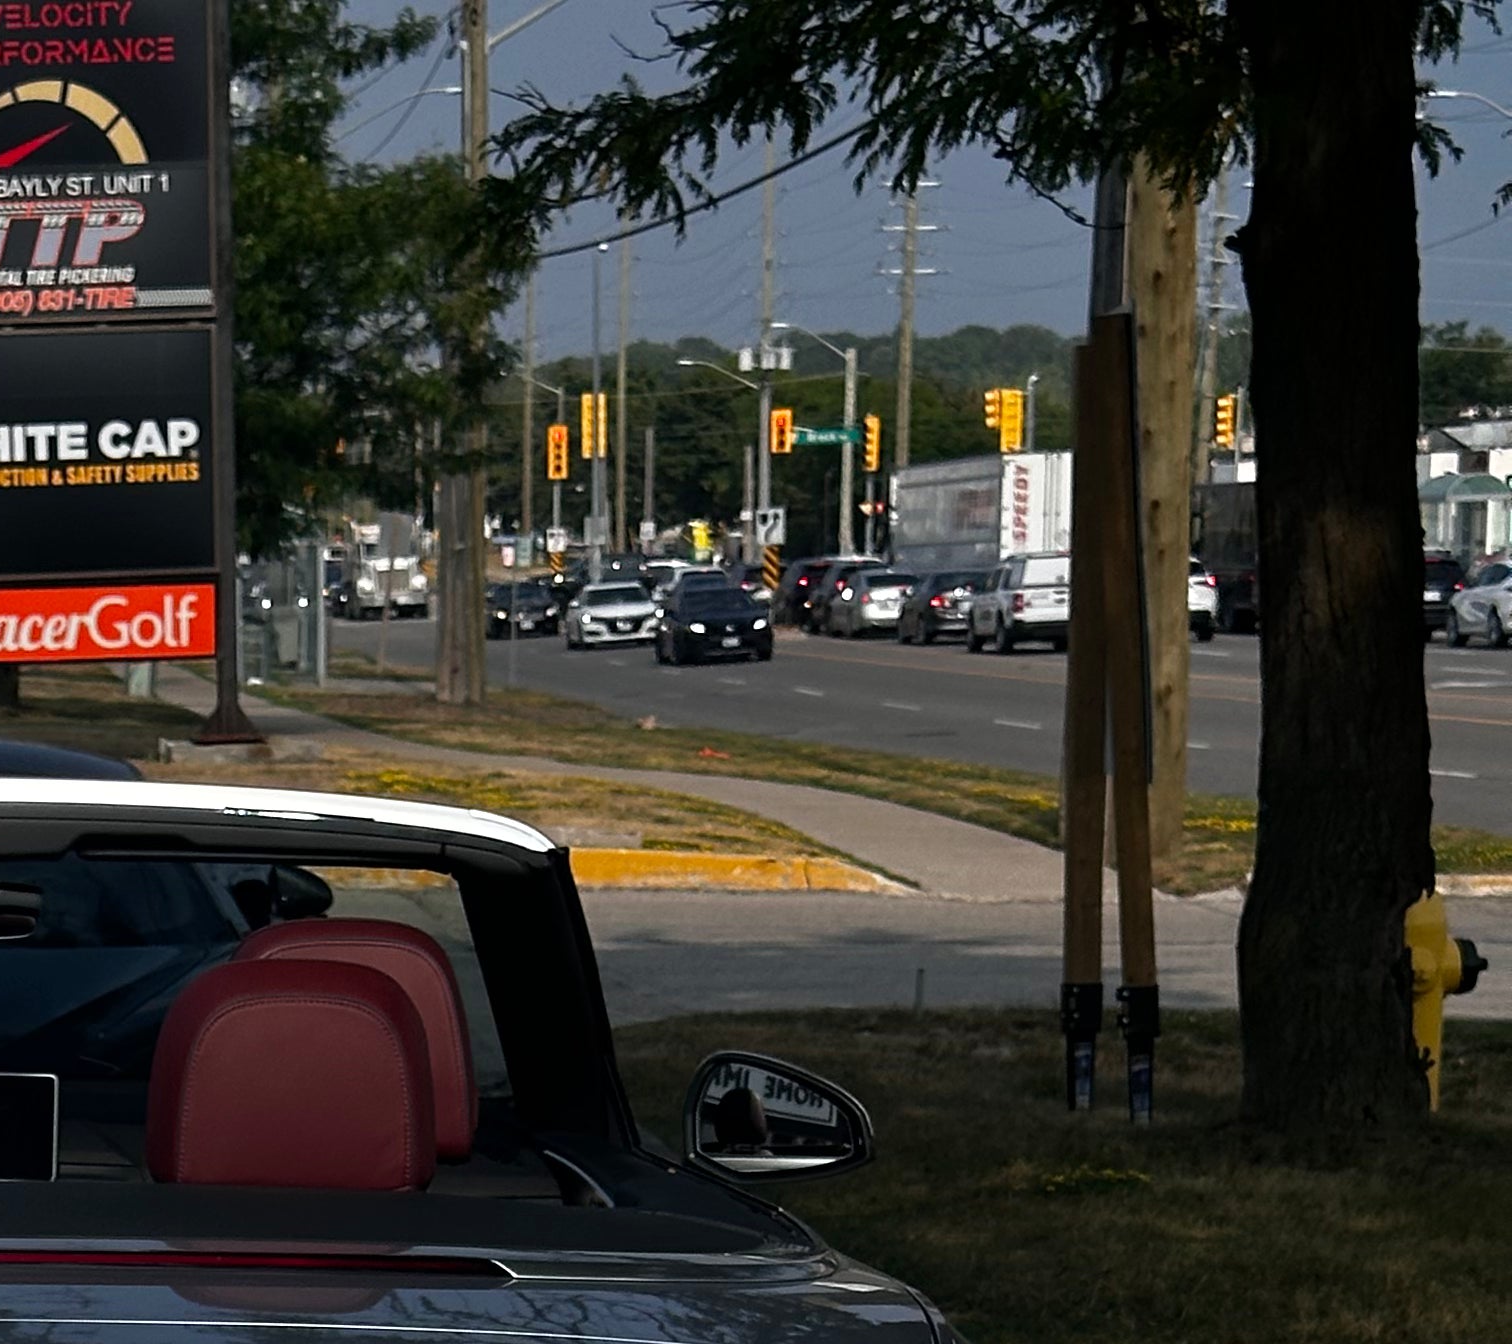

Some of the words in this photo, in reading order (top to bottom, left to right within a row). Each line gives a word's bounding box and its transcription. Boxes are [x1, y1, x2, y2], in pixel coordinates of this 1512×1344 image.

[65, 174, 100, 195] ST.
[103, 174, 154, 195] UNIT
[158, 173, 170, 192] 1
[26, 269, 57, 285] TIRE
[58, 267, 136, 285] PICKERING
[97, 418, 201, 460] CAP
[51, 469, 64, 486] &
[66, 465, 123, 486] SAFETY
[125, 462, 201, 483] SUPPLIES
[1012, 464, 1030, 544] SPEEDY
